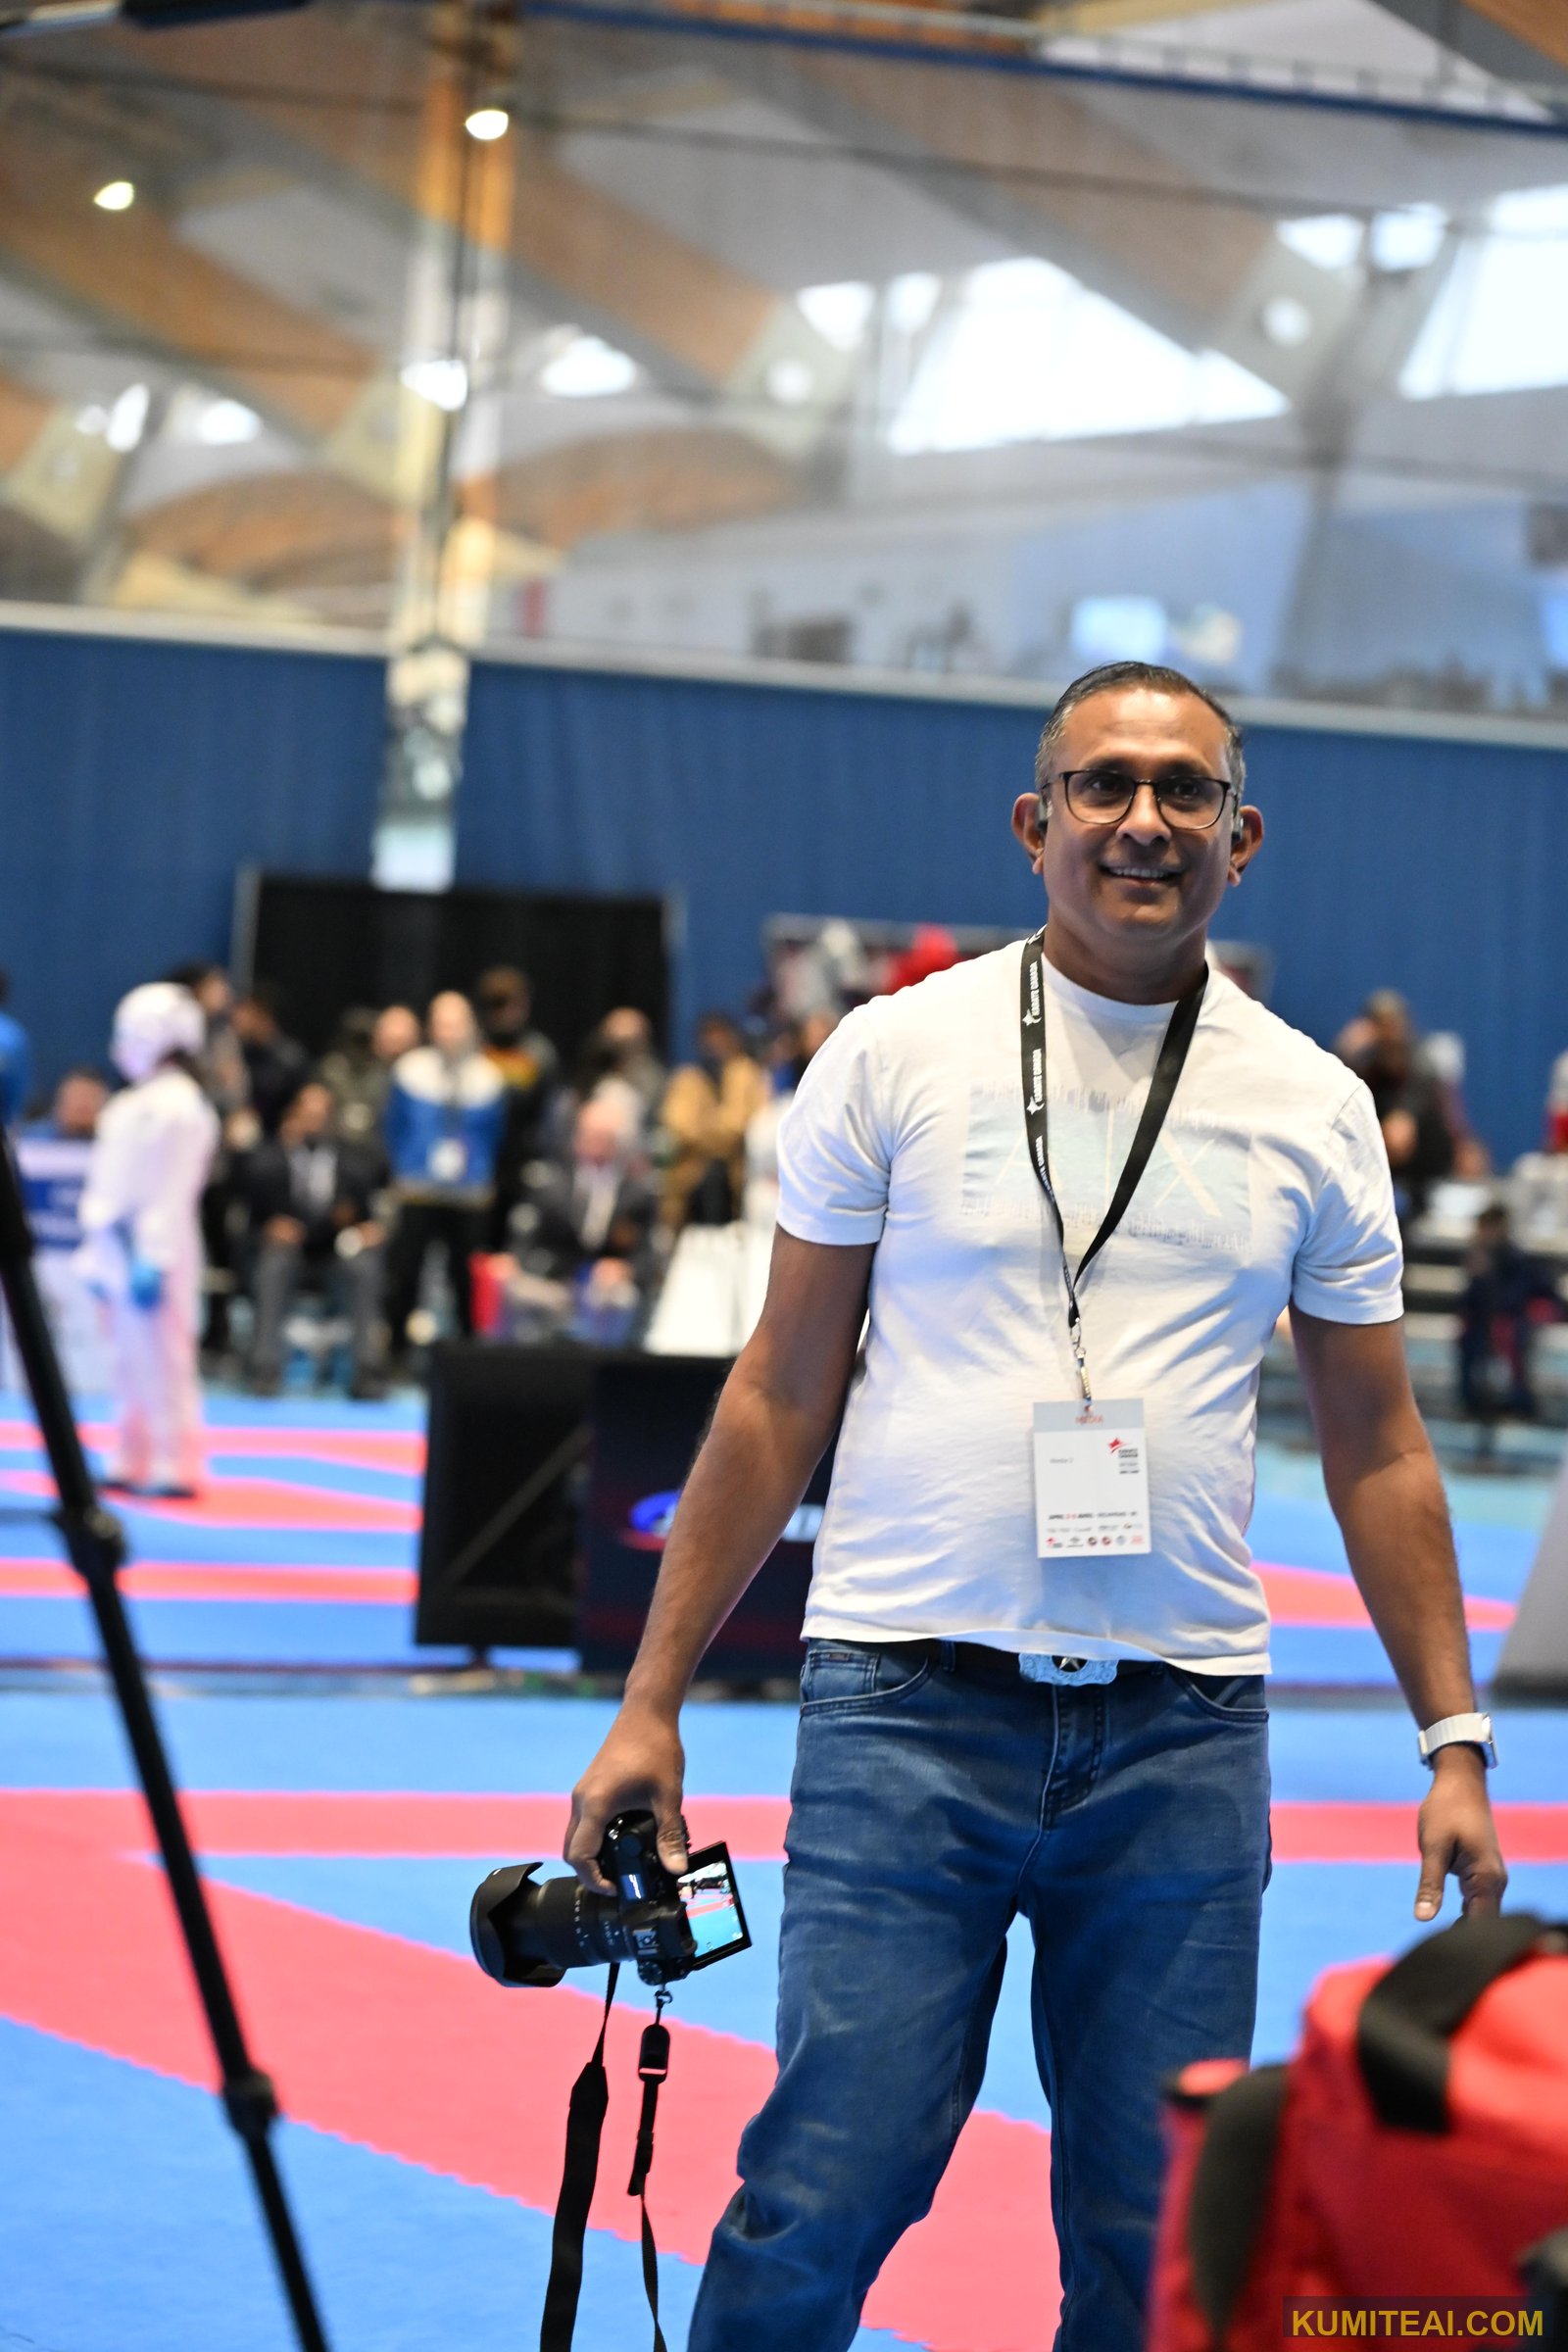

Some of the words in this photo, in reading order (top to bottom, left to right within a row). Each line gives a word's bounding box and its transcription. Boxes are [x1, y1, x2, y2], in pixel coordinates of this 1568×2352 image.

[1029, 961, 1039, 990] CANADA
[1031, 989, 1040, 1016] KARATE
[1033, 1049, 1042, 1076] CANADA
[1033, 1075, 1043, 1102] KARATE
